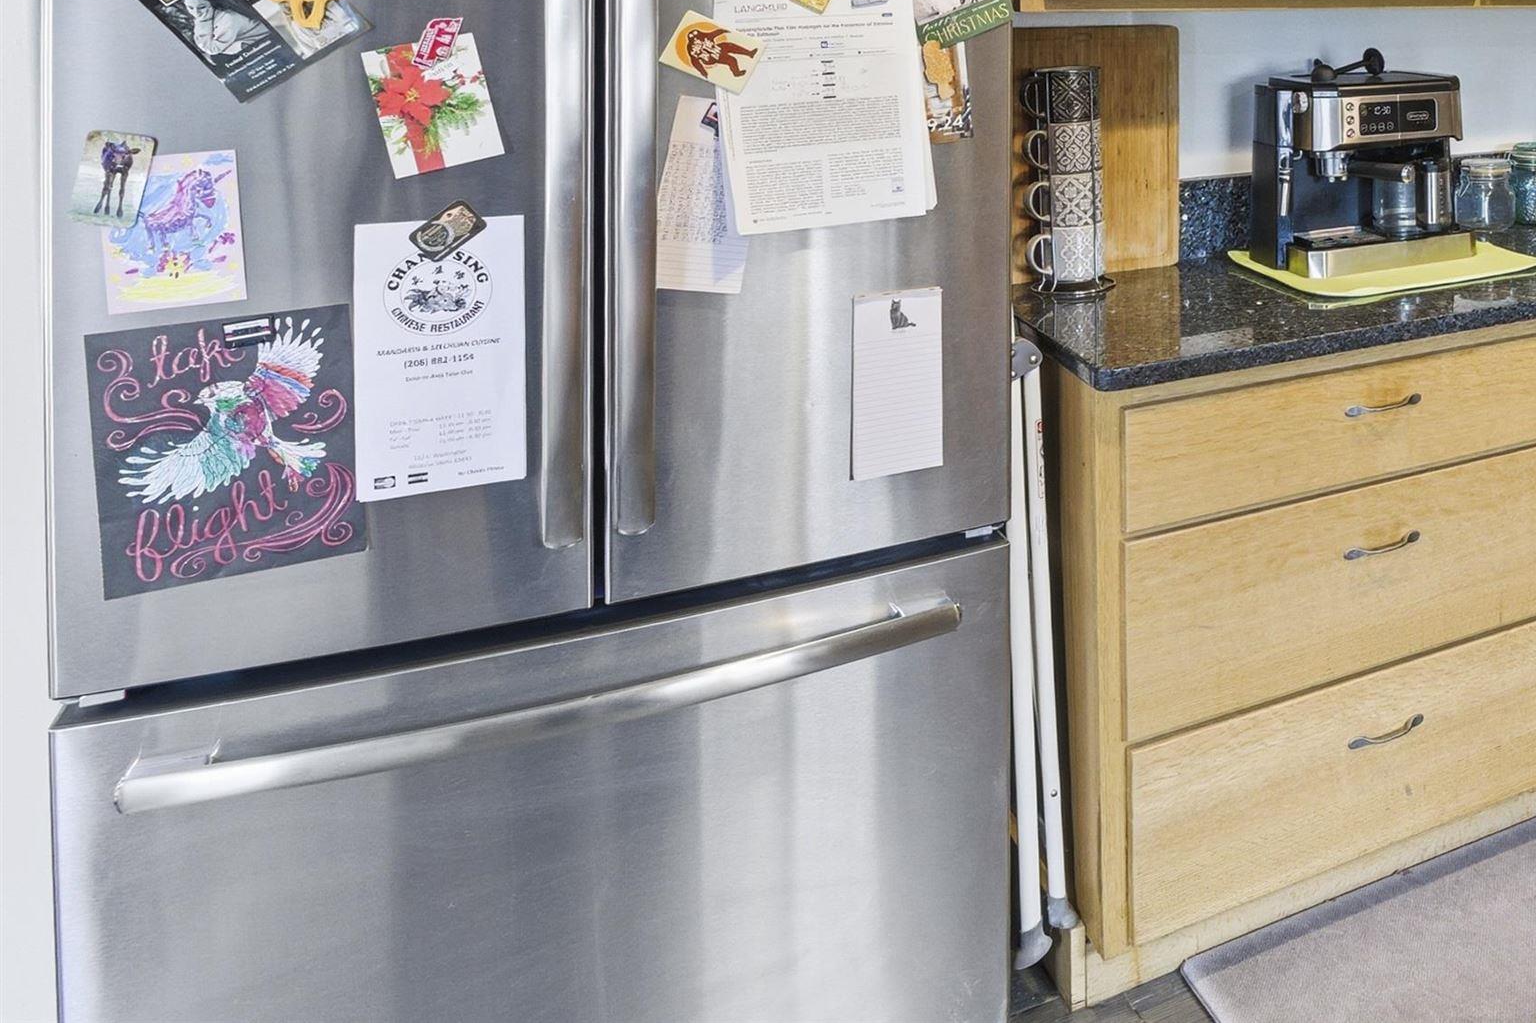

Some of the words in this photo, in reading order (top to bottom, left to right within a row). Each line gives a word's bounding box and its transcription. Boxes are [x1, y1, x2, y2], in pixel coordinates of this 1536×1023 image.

[452, 250, 490, 284] SING
[391, 306, 427, 333] CHINESE
[430, 299, 486, 334] RESTAURANT
[126, 469, 288, 582] flight
